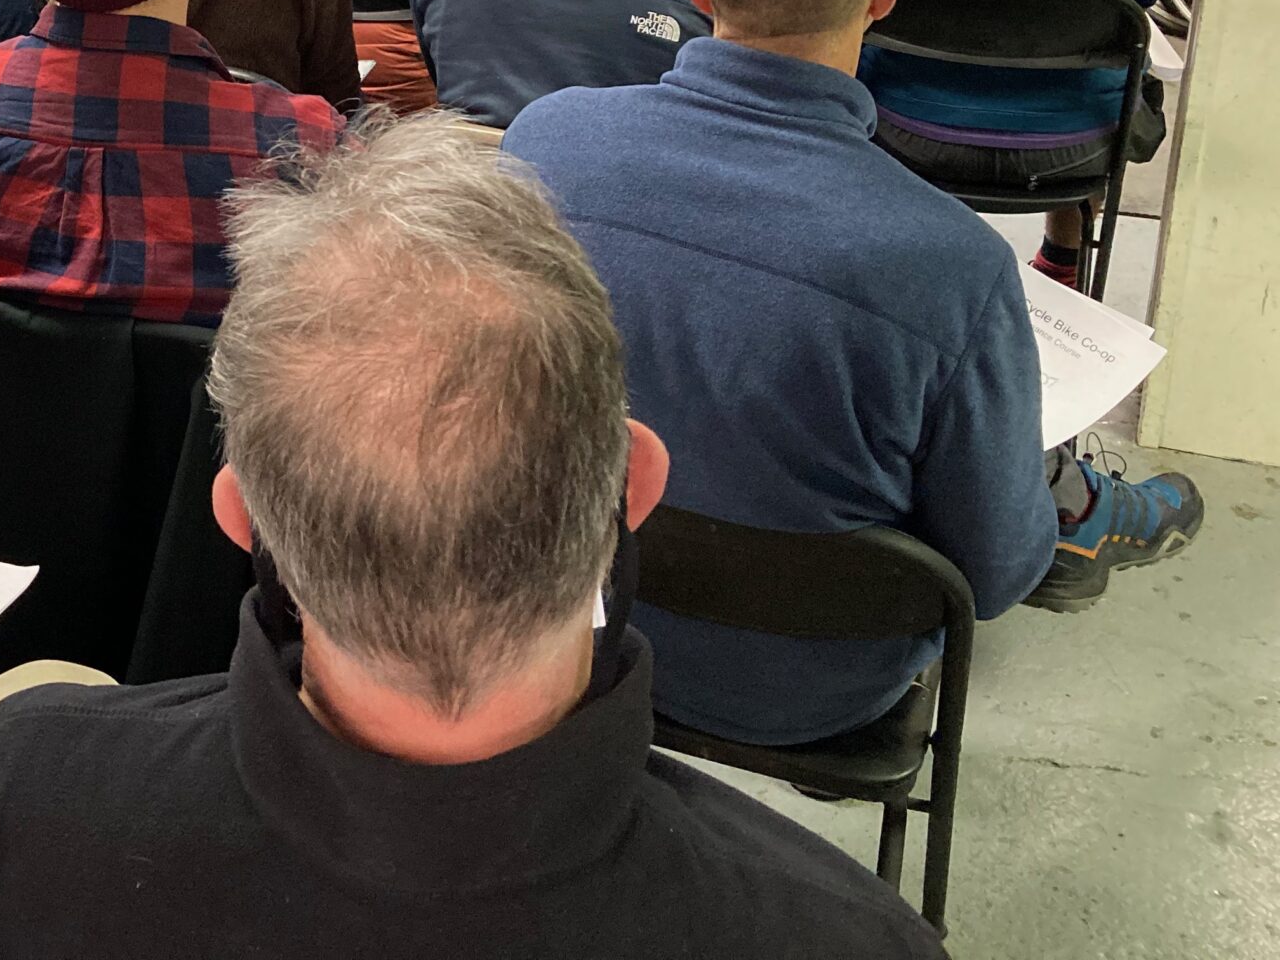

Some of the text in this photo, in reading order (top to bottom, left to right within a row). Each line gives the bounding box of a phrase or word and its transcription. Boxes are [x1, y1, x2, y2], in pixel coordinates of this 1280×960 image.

[630, 14, 665, 31] NORTH
[647, 11, 668, 23] THE
[637, 24, 664, 38] FACE
[1053, 318, 1079, 342] Bike
[1080, 336, 1116, 365] Co-op
[1053, 333, 1082, 359] Course
